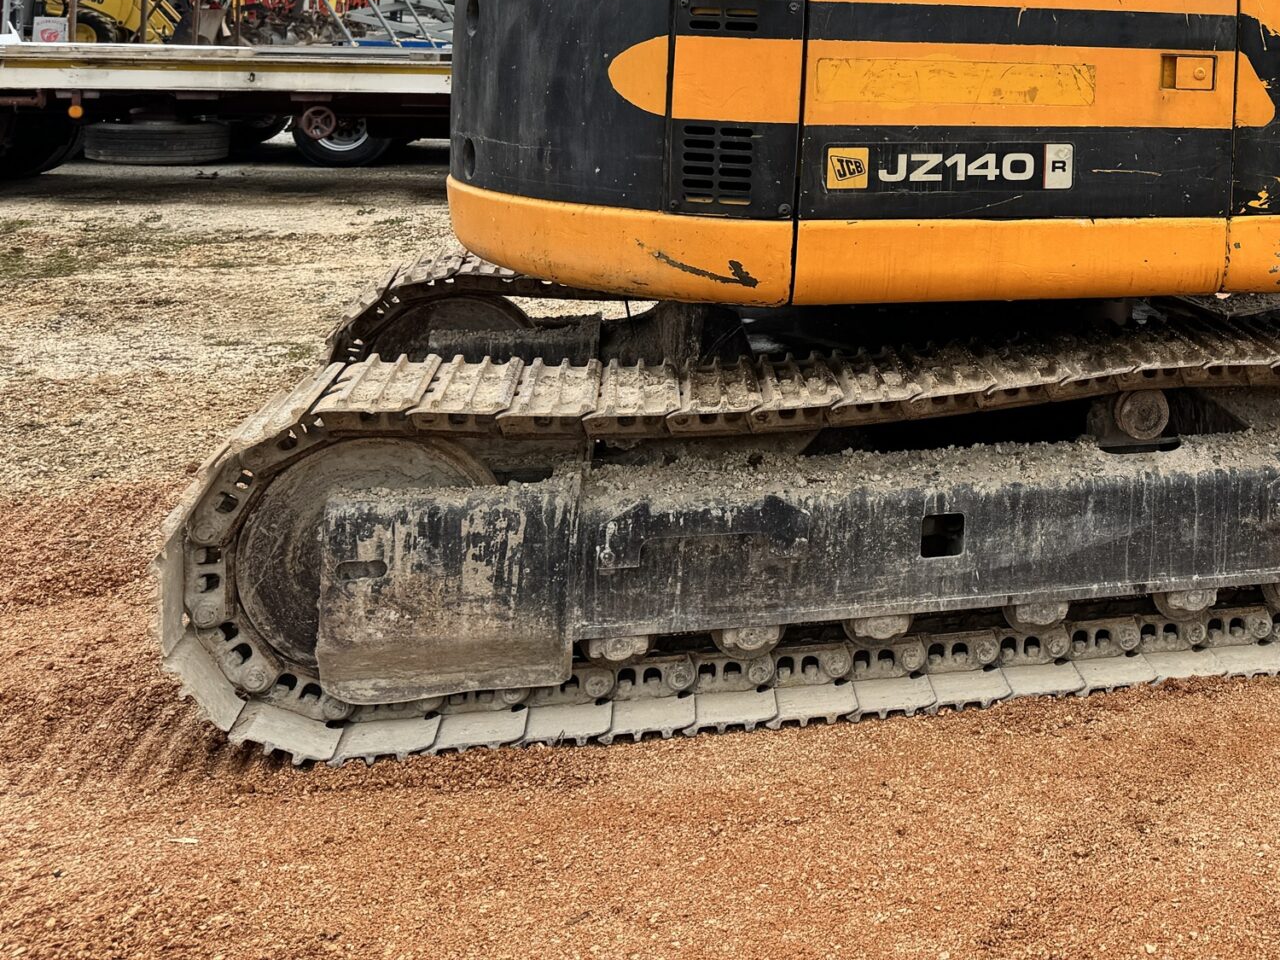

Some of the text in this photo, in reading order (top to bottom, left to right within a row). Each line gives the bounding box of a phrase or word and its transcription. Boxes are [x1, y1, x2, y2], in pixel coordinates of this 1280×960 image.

[836, 152, 1067, 183] JCB JZ140 R
